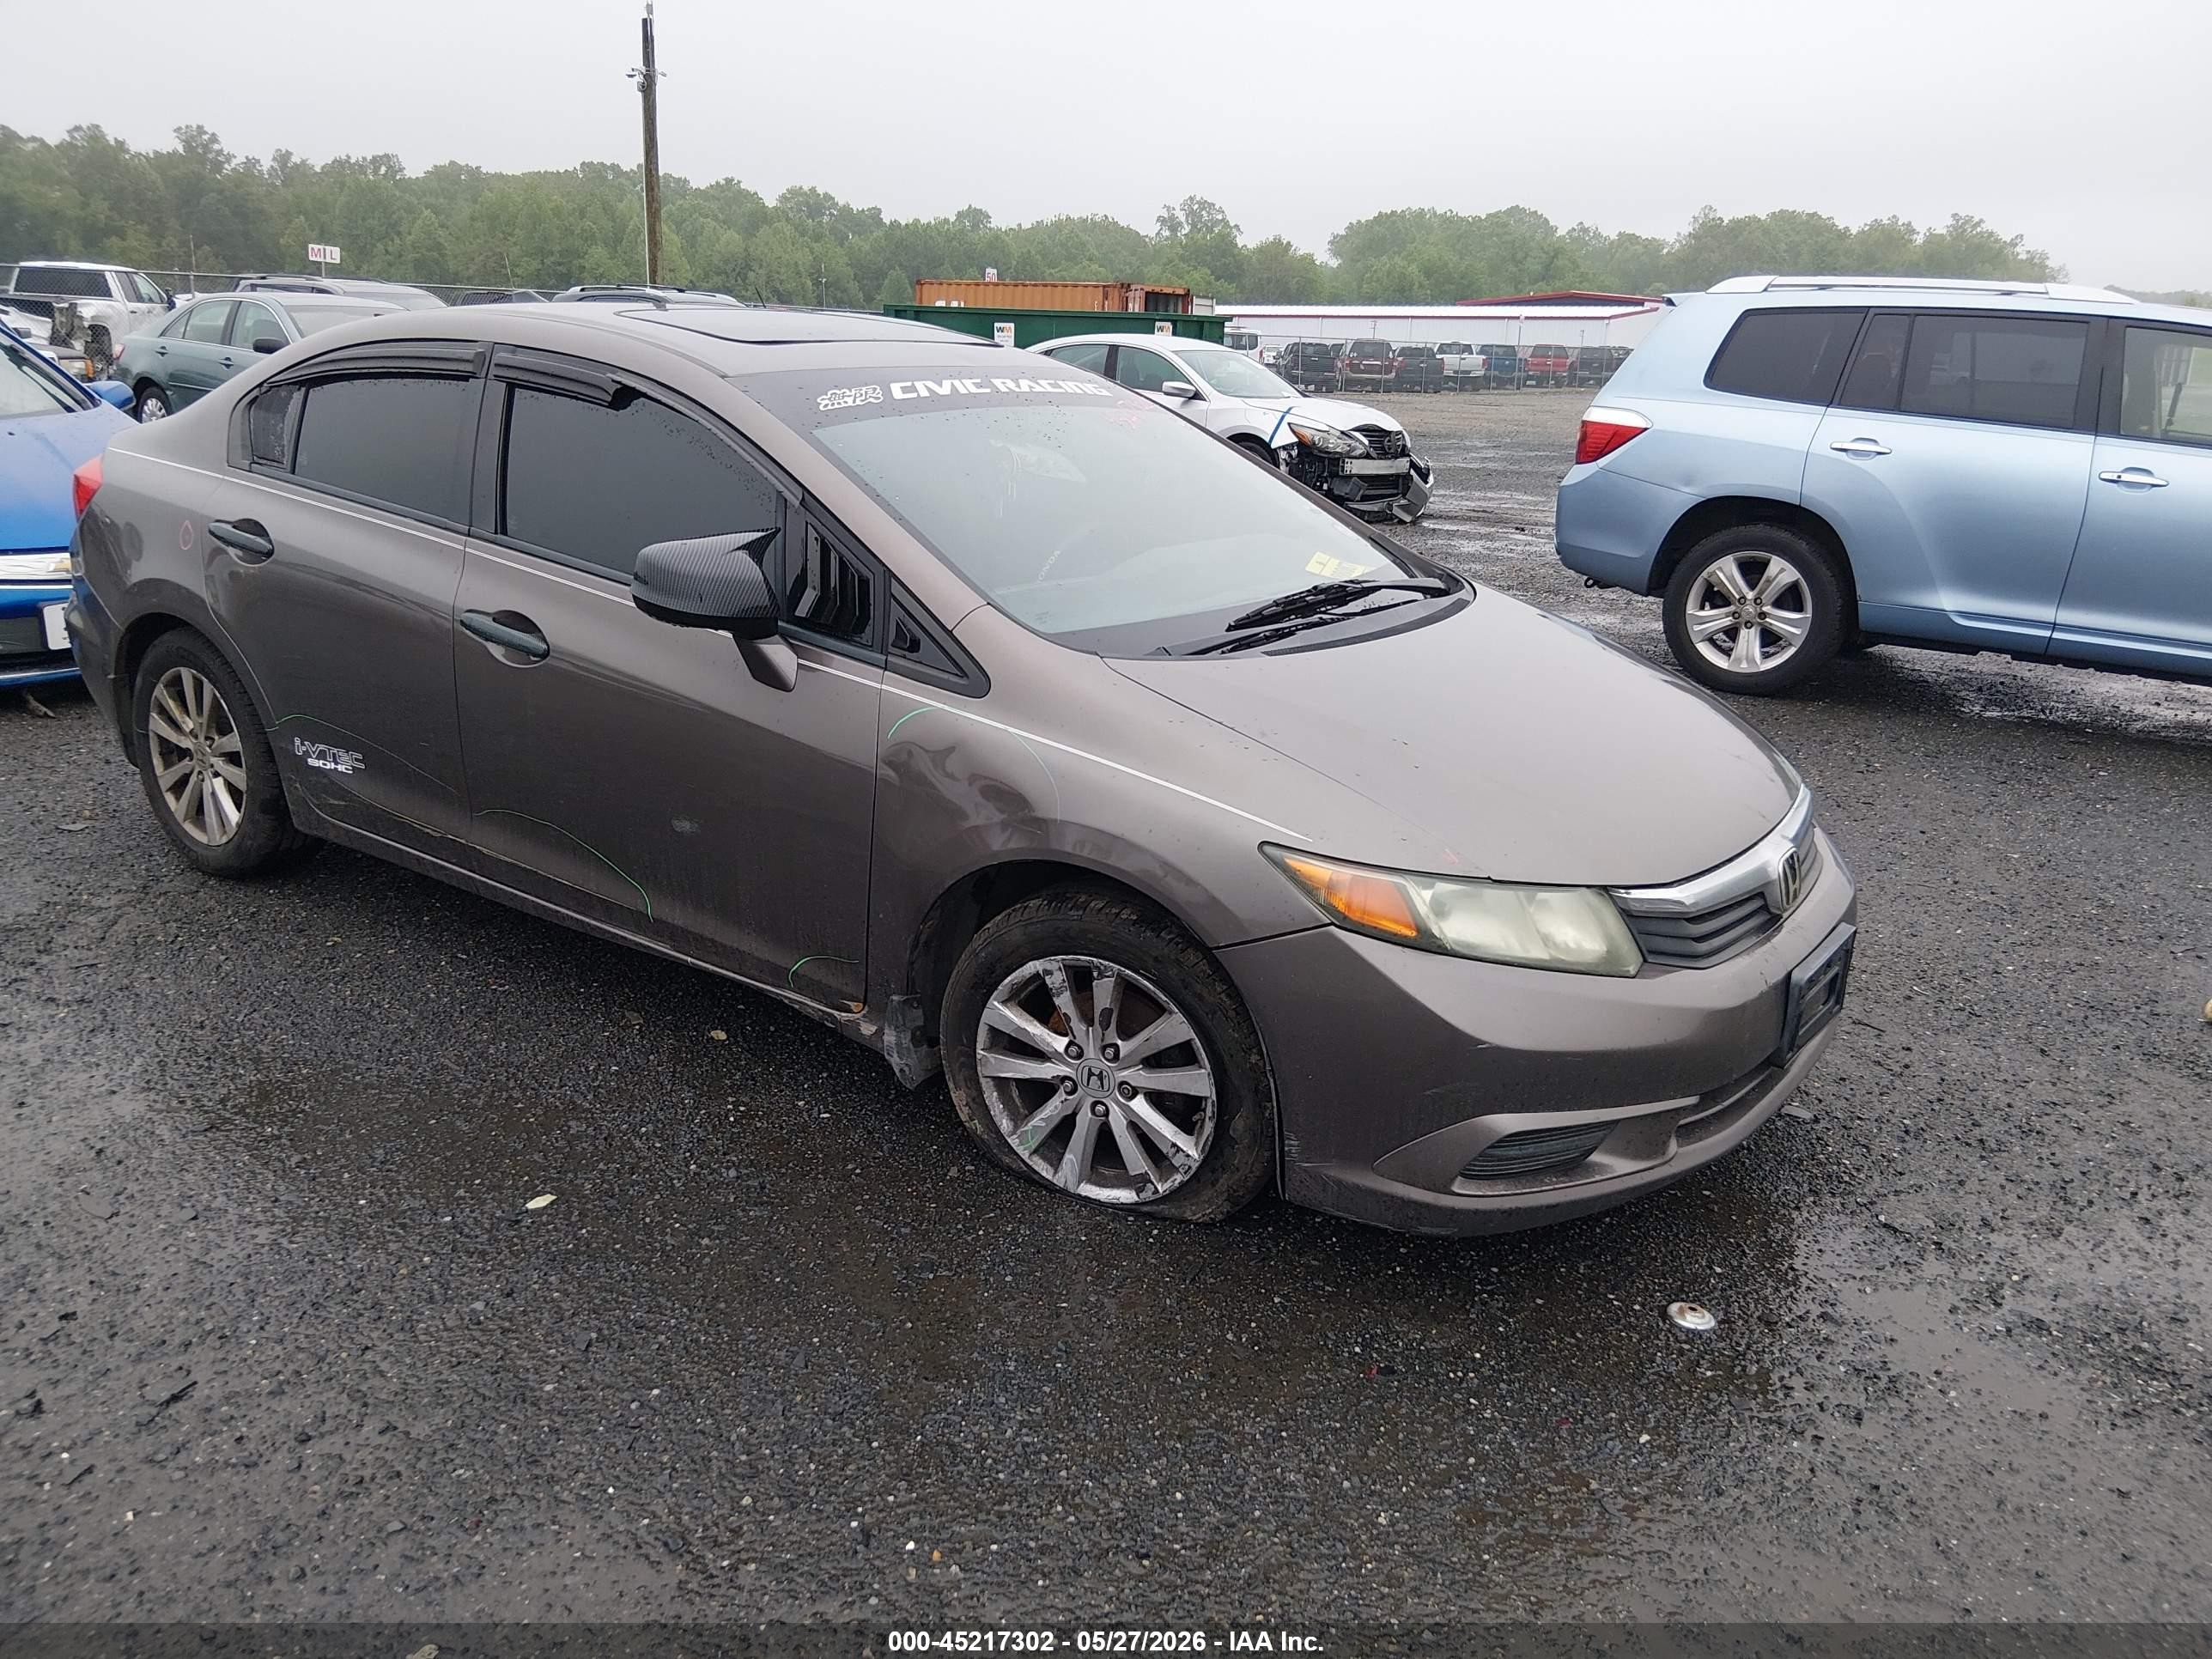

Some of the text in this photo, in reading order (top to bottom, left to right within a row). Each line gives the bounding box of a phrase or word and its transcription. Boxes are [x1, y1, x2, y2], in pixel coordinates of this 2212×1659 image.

[817, 385, 884, 410] 無限
[890, 377, 1113, 400] CIVIC RACING
[294, 736, 366, 769] i-VTEC
[307, 757, 353, 774] SOHC
